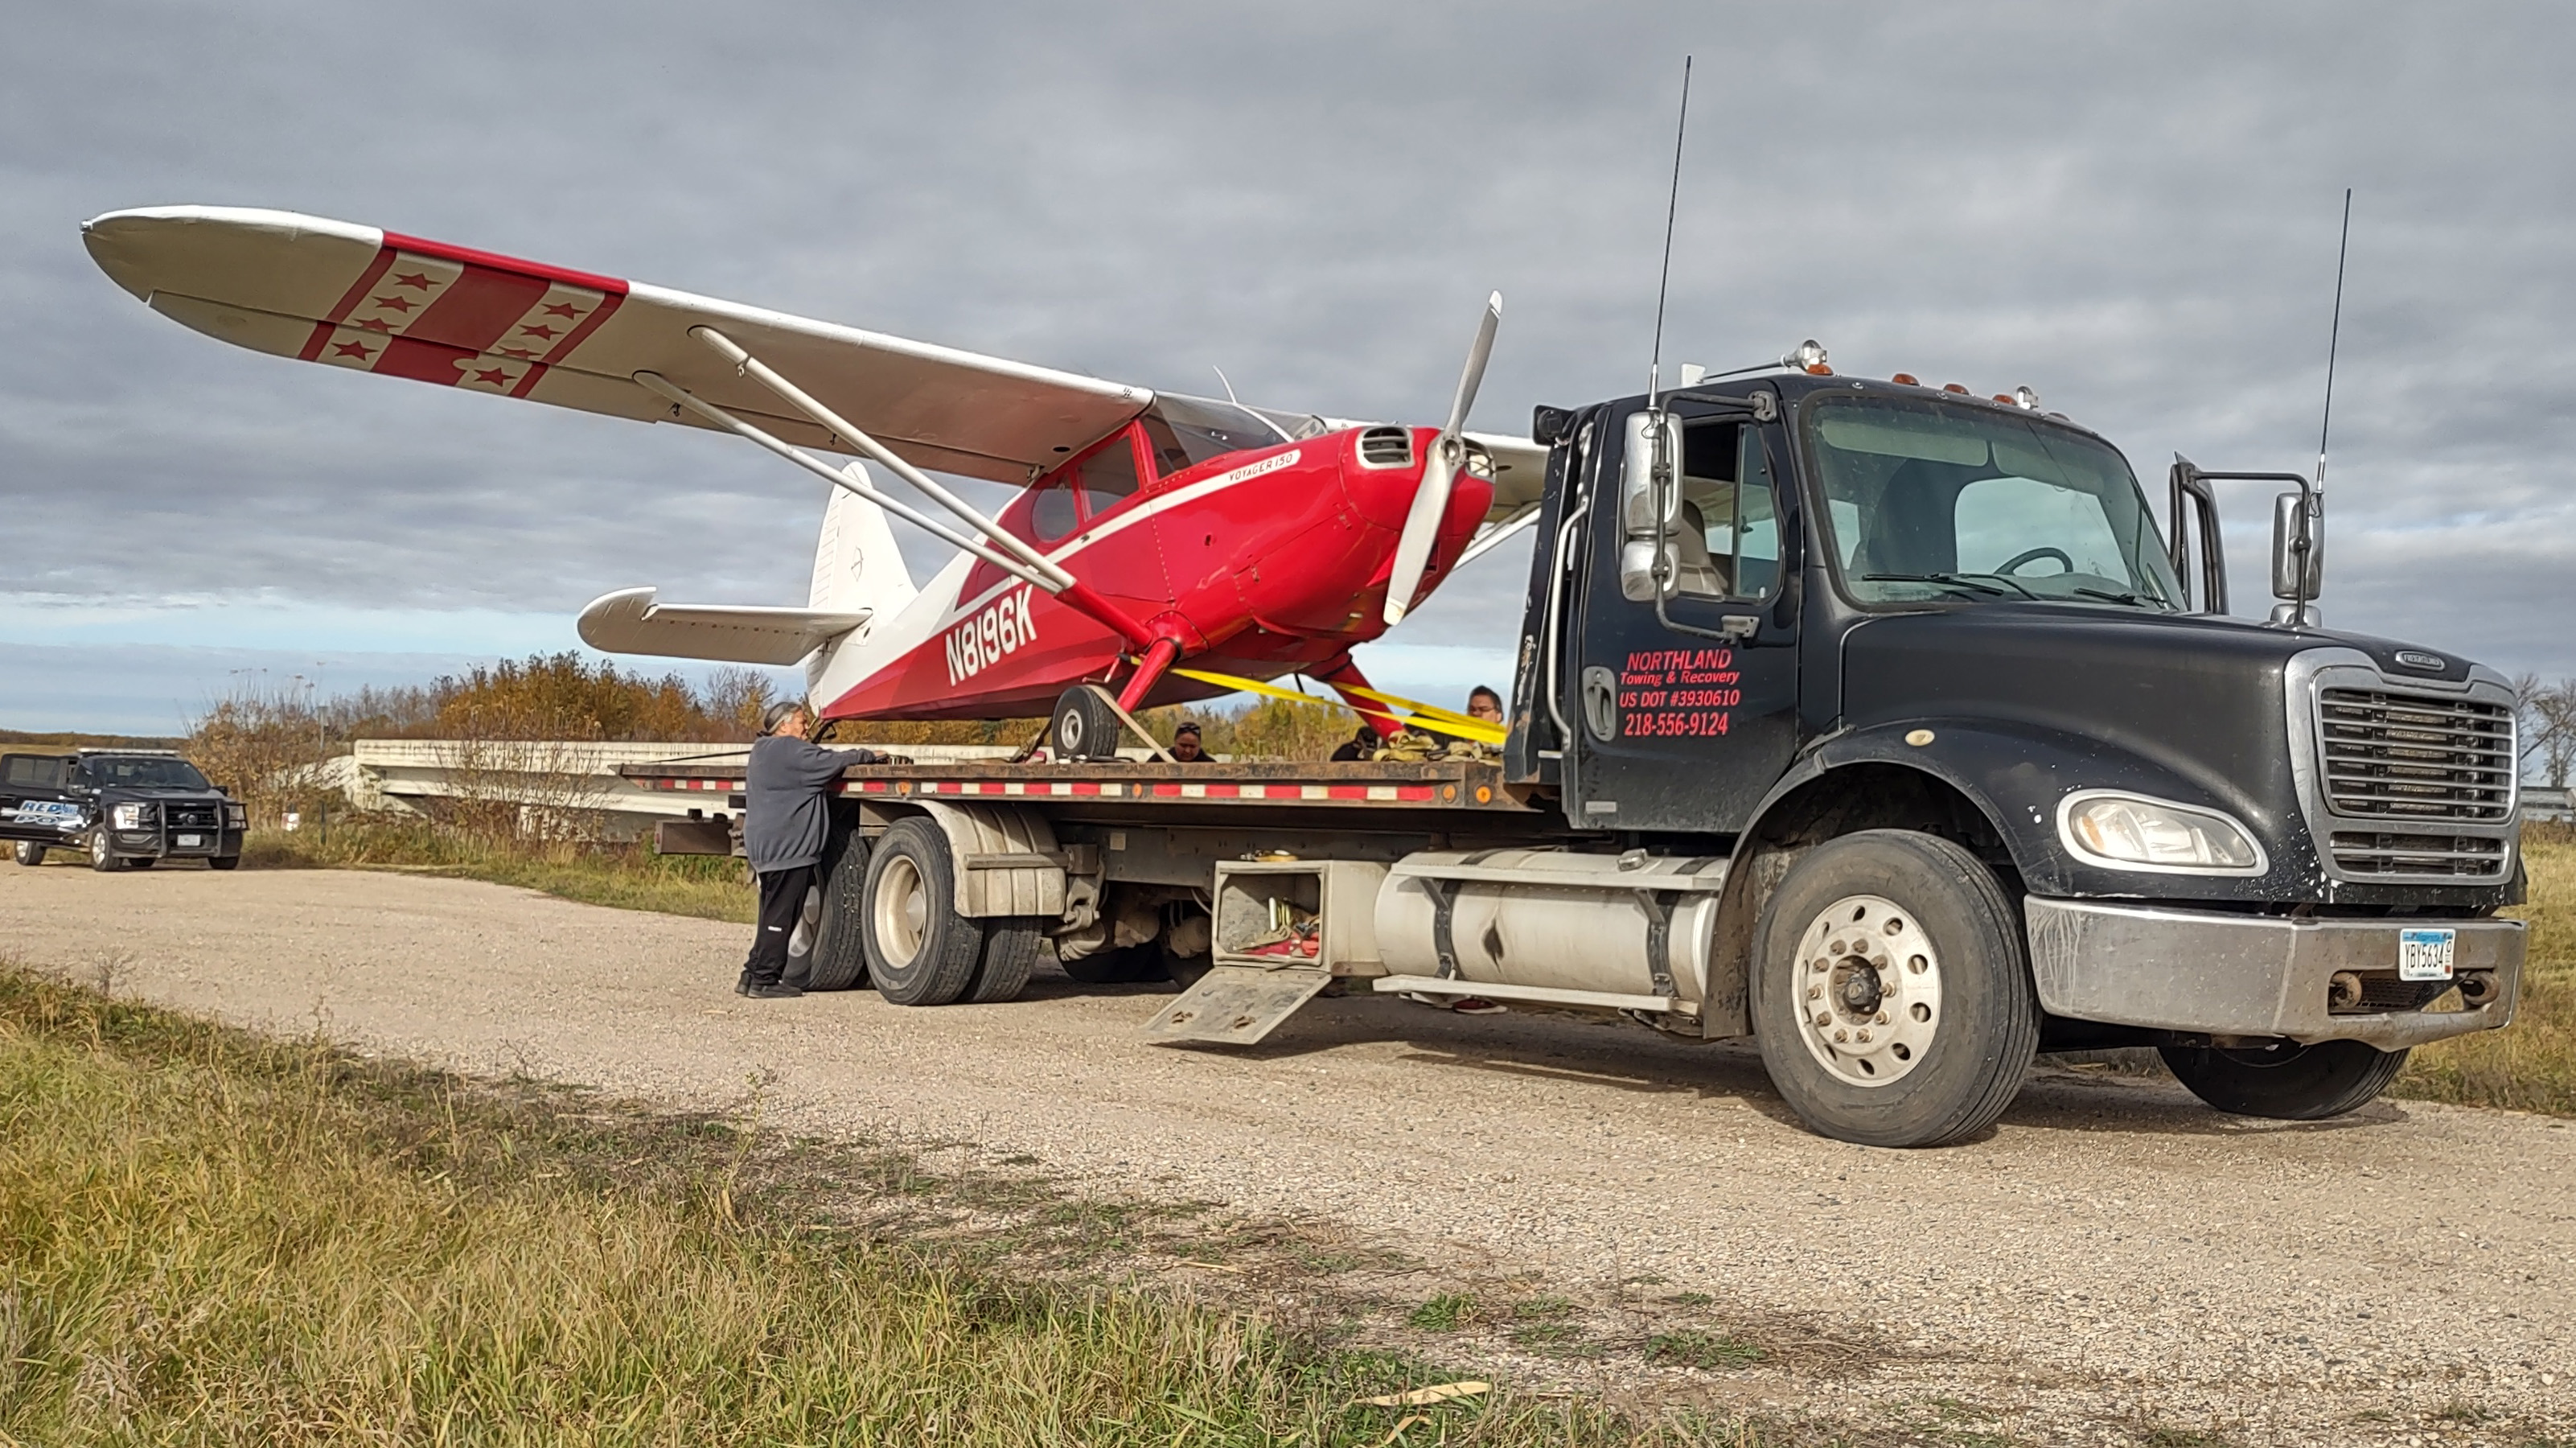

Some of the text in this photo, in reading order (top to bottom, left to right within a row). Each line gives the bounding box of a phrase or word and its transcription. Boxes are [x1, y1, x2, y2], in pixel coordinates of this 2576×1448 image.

[1229, 453, 1293, 481] VOYAGER 150
[945, 583, 1037, 687] N8196K
[1626, 648, 1732, 671] NORTHLAND
[1620, 671, 1740, 686] Towing & Recovery
[1619, 689, 1740, 708] US DOT #3930610
[1624, 711, 1729, 736] 218-556-9124
[2405, 944, 2444, 969] YBY5634
